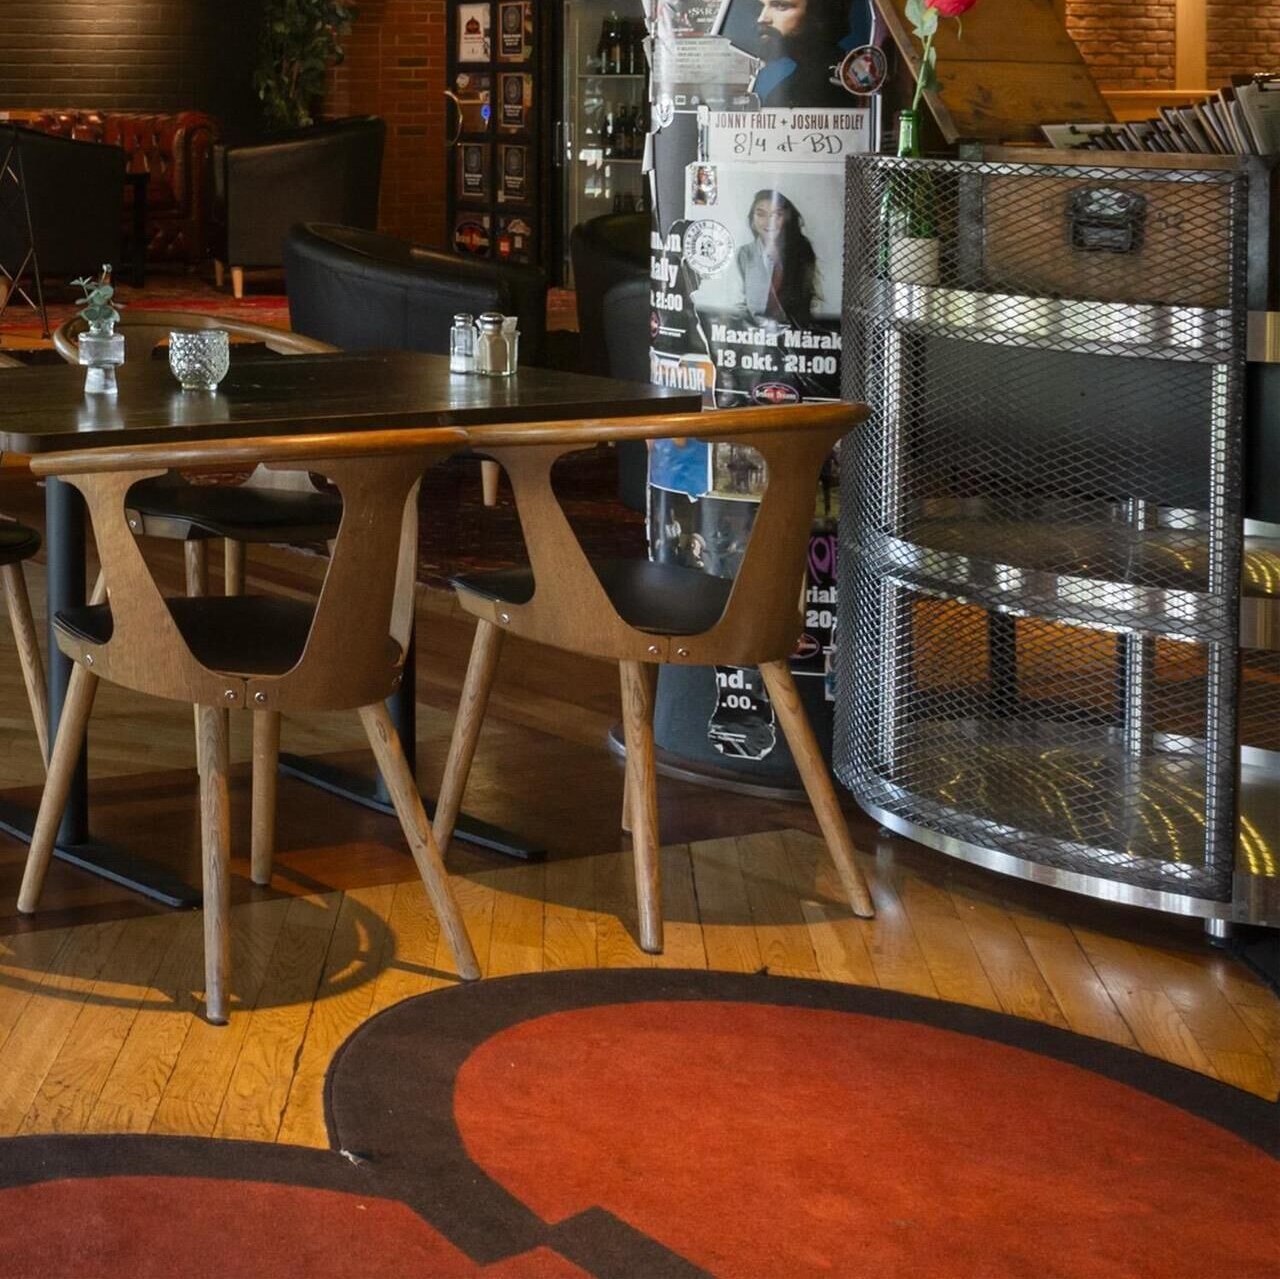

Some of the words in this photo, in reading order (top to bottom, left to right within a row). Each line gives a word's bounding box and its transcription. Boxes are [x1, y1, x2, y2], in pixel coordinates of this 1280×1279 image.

[715, 113, 748, 129] JONNY
[751, 113, 776, 130] FRITZ
[790, 113, 829, 130] JOSHUA
[833, 113, 864, 130] HEDLEY
[803, 132, 843, 154] BD
[711, 323, 778, 347] Maxida
[717, 349, 736, 368] 13
[741, 353, 778, 371] okt.
[784, 354, 837, 374] 21:00
